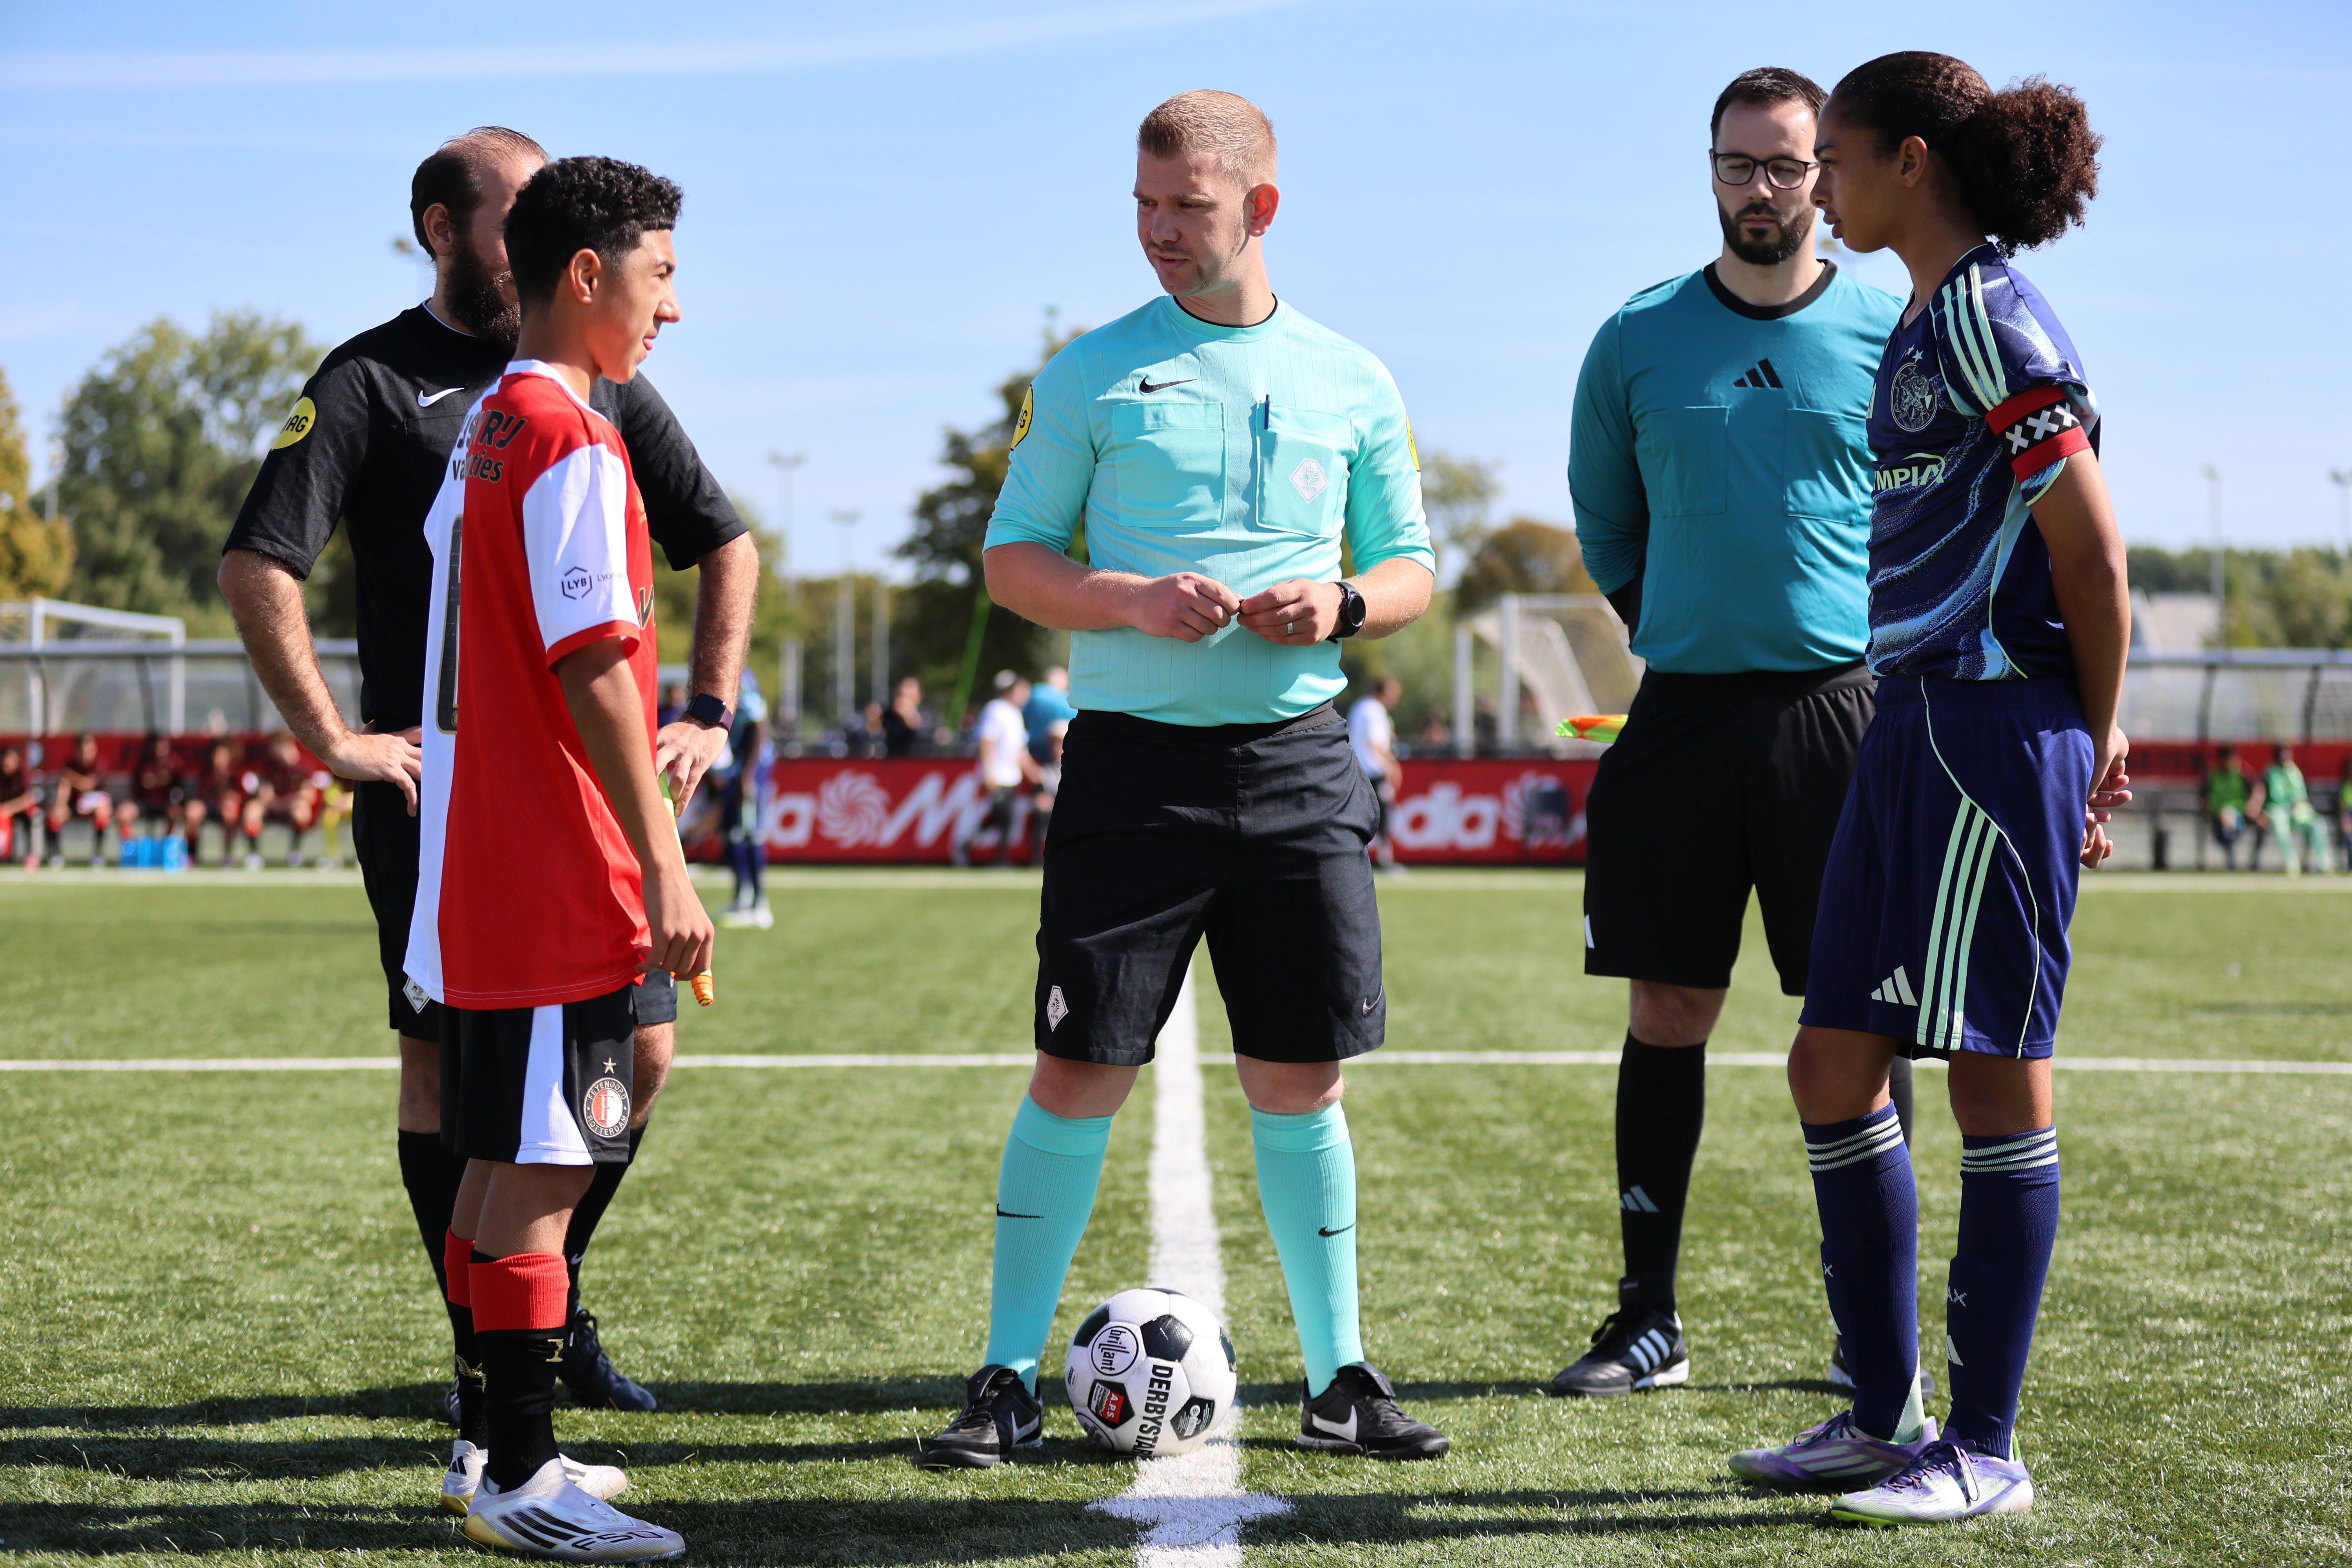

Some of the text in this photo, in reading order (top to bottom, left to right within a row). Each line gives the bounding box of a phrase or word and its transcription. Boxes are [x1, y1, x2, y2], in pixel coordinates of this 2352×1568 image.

[281, 415, 309, 432] AG
[1875, 464, 1944, 491] MPIA
[568, 578, 588, 590] LYB
[588, 1081, 626, 1100] FEYENOORD
[588, 1115, 627, 1136] ROTTERDAM
[1098, 1329, 1130, 1371] brillant
[1106, 1393, 1119, 1419] A.P.S.
[1131, 1365, 1173, 1457] DERBYSTAR
